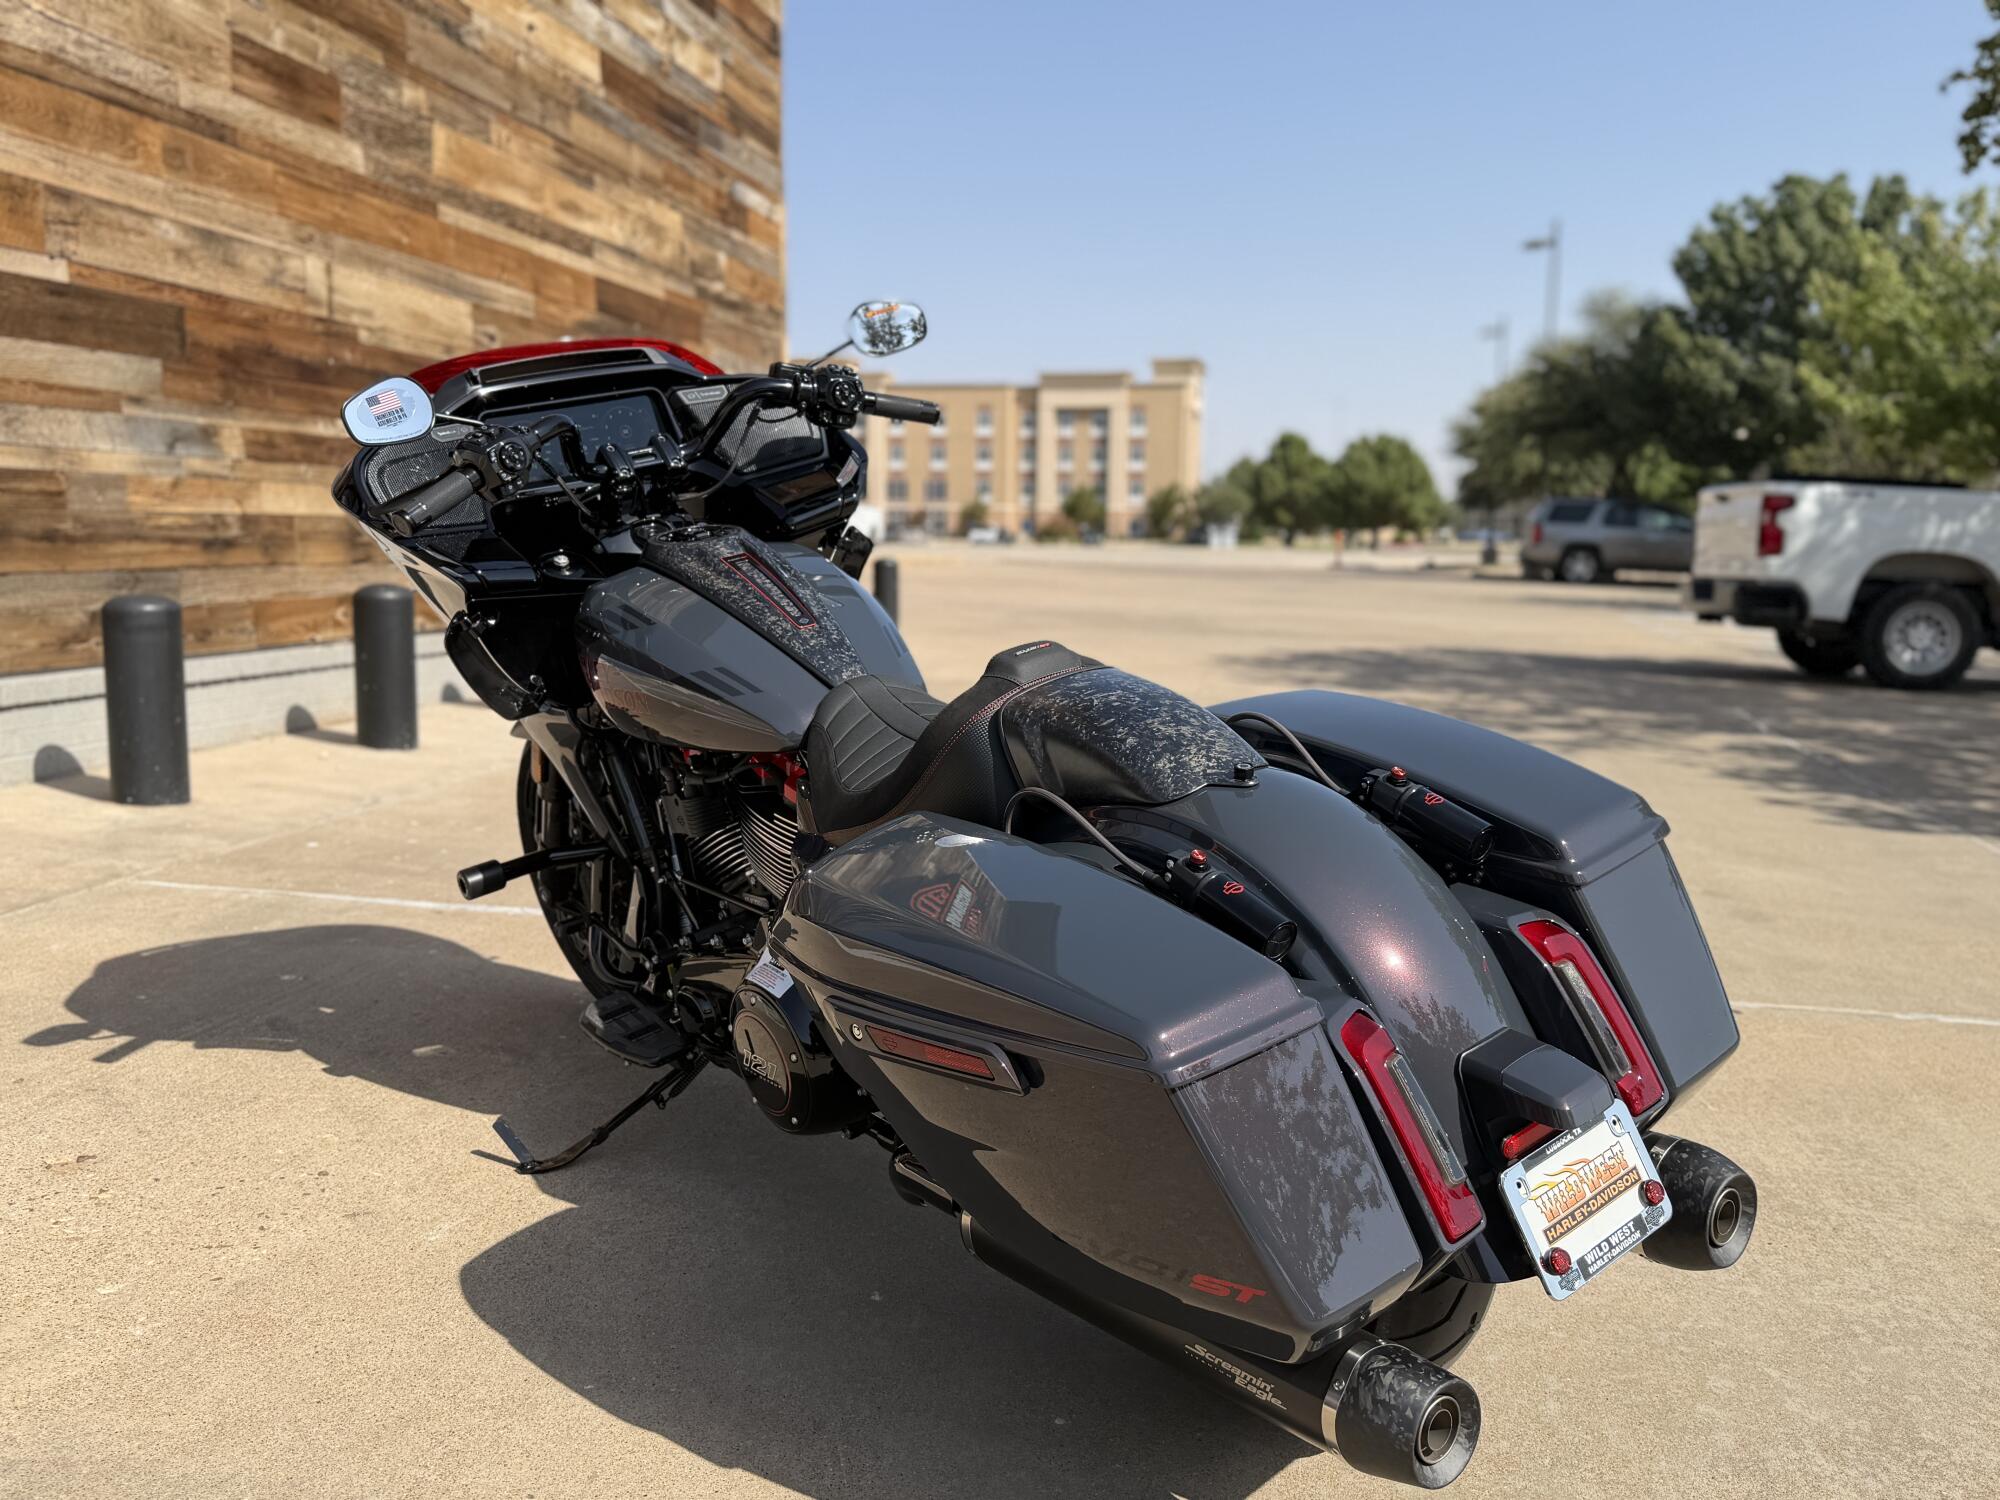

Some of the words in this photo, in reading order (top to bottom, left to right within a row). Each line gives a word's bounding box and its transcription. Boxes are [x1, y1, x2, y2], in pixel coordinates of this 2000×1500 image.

[743, 1048, 777, 1080] 121
[1572, 1127, 1583, 1136] TX
[1534, 1173, 1586, 1223] WILD
[1577, 1140, 1629, 1193] WEST
[1547, 1170, 1640, 1241] HARLEY-DAVIDSON
[1584, 1241, 1610, 1265] WILD
[1609, 1221, 1635, 1246] WEST
[1588, 1230, 1641, 1274] HARLEY-DAVIDSON
[1234, 1375, 1287, 1410] Eagle
